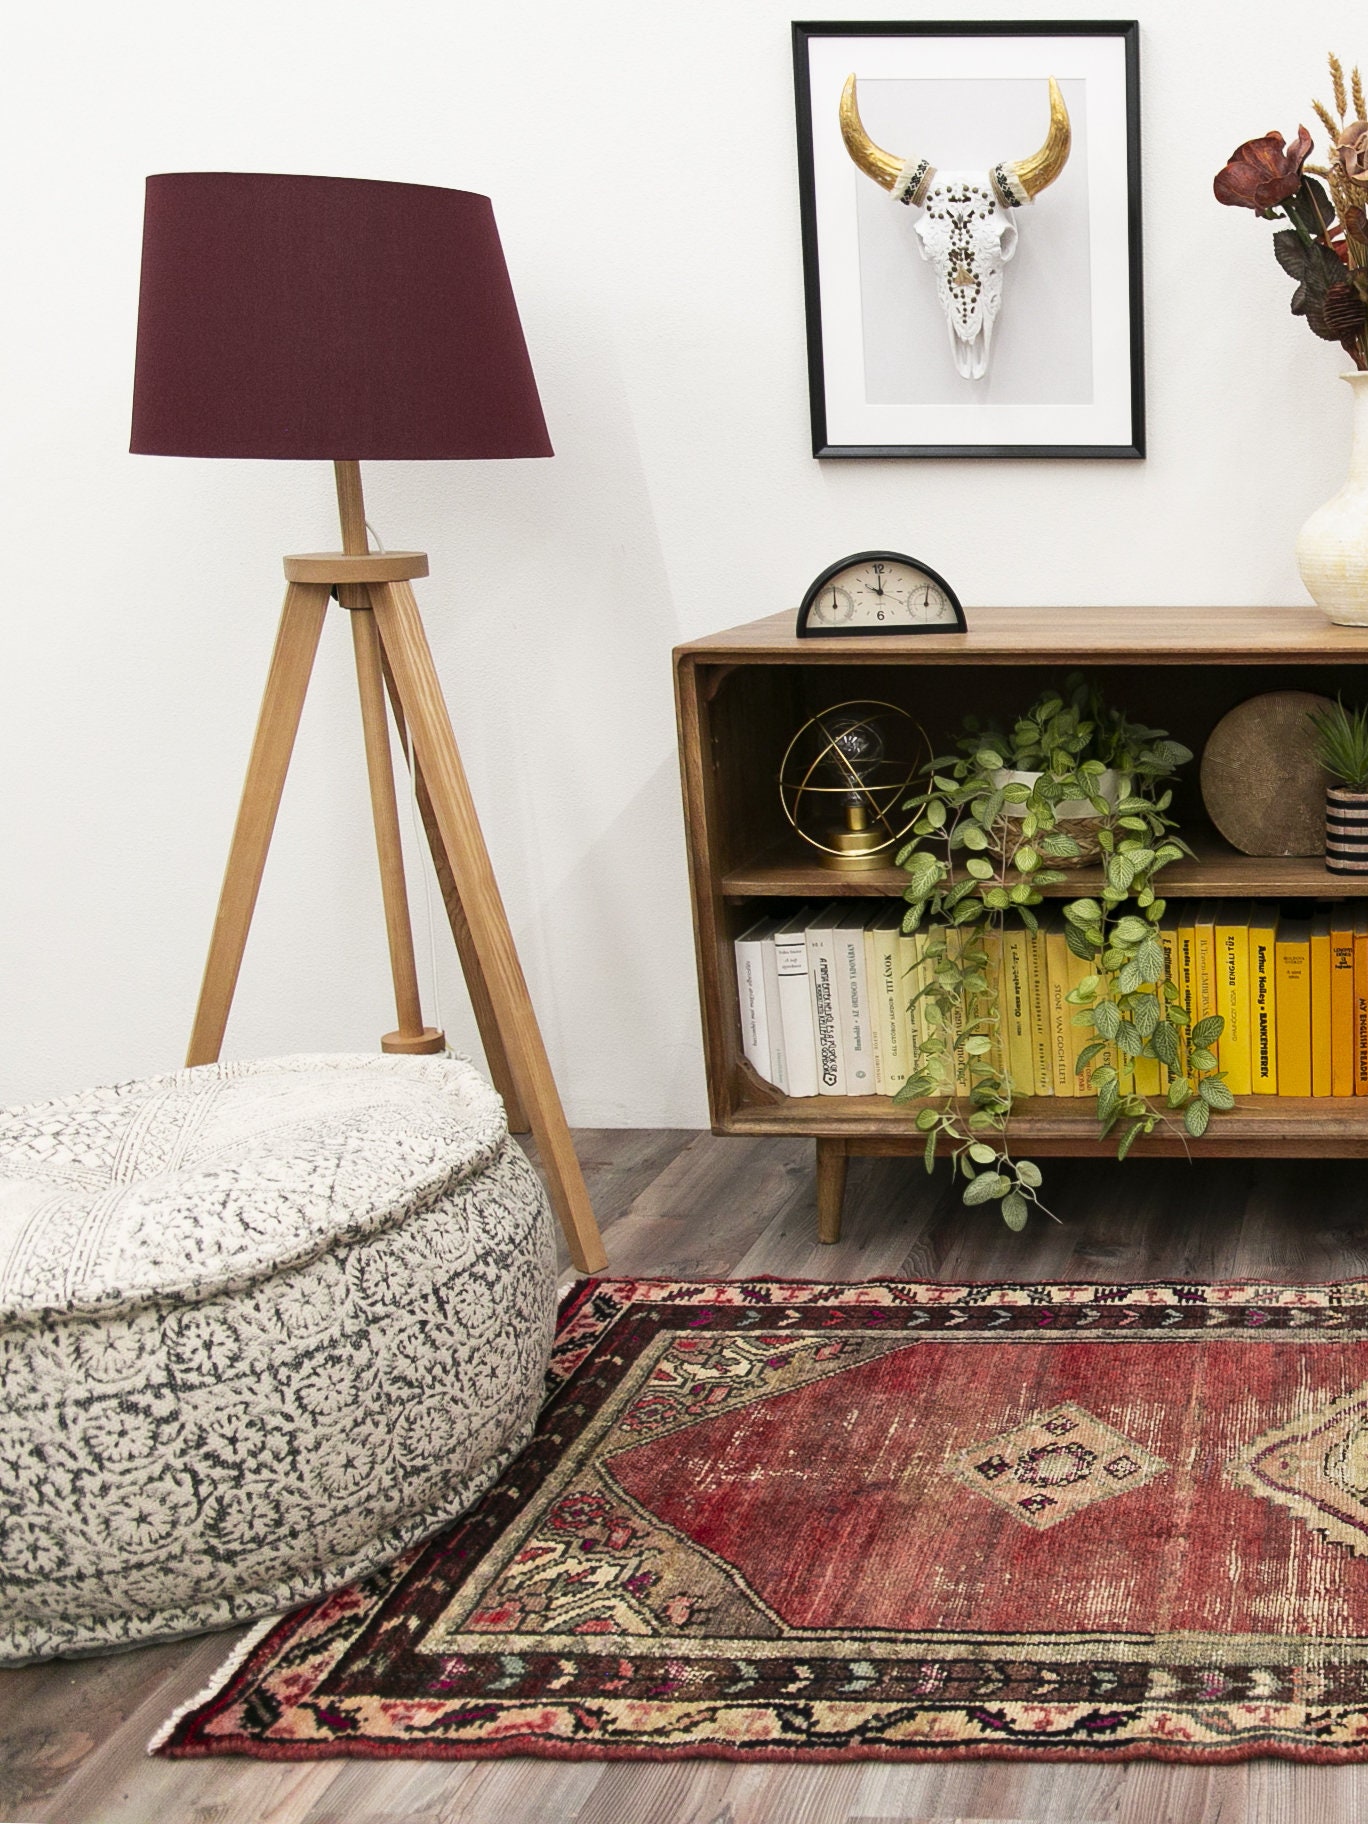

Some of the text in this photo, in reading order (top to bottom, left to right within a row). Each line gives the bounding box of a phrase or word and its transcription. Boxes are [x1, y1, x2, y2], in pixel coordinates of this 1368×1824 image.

[872, 564, 884, 574] 12
[877, 611, 884, 620] 6
[1257, 945, 1267, 973] Arthur
[883, 954, 894, 994] TITÁNOK
[1054, 984, 1063, 1011] STONE
[1055, 1016, 1064, 1034] VAN
[1056, 1035, 1065, 1062] GOGH
[1259, 1012, 1269, 1078] BANKEMBEREK
[1359, 998, 1368, 1082] MY ENGLISH READER
